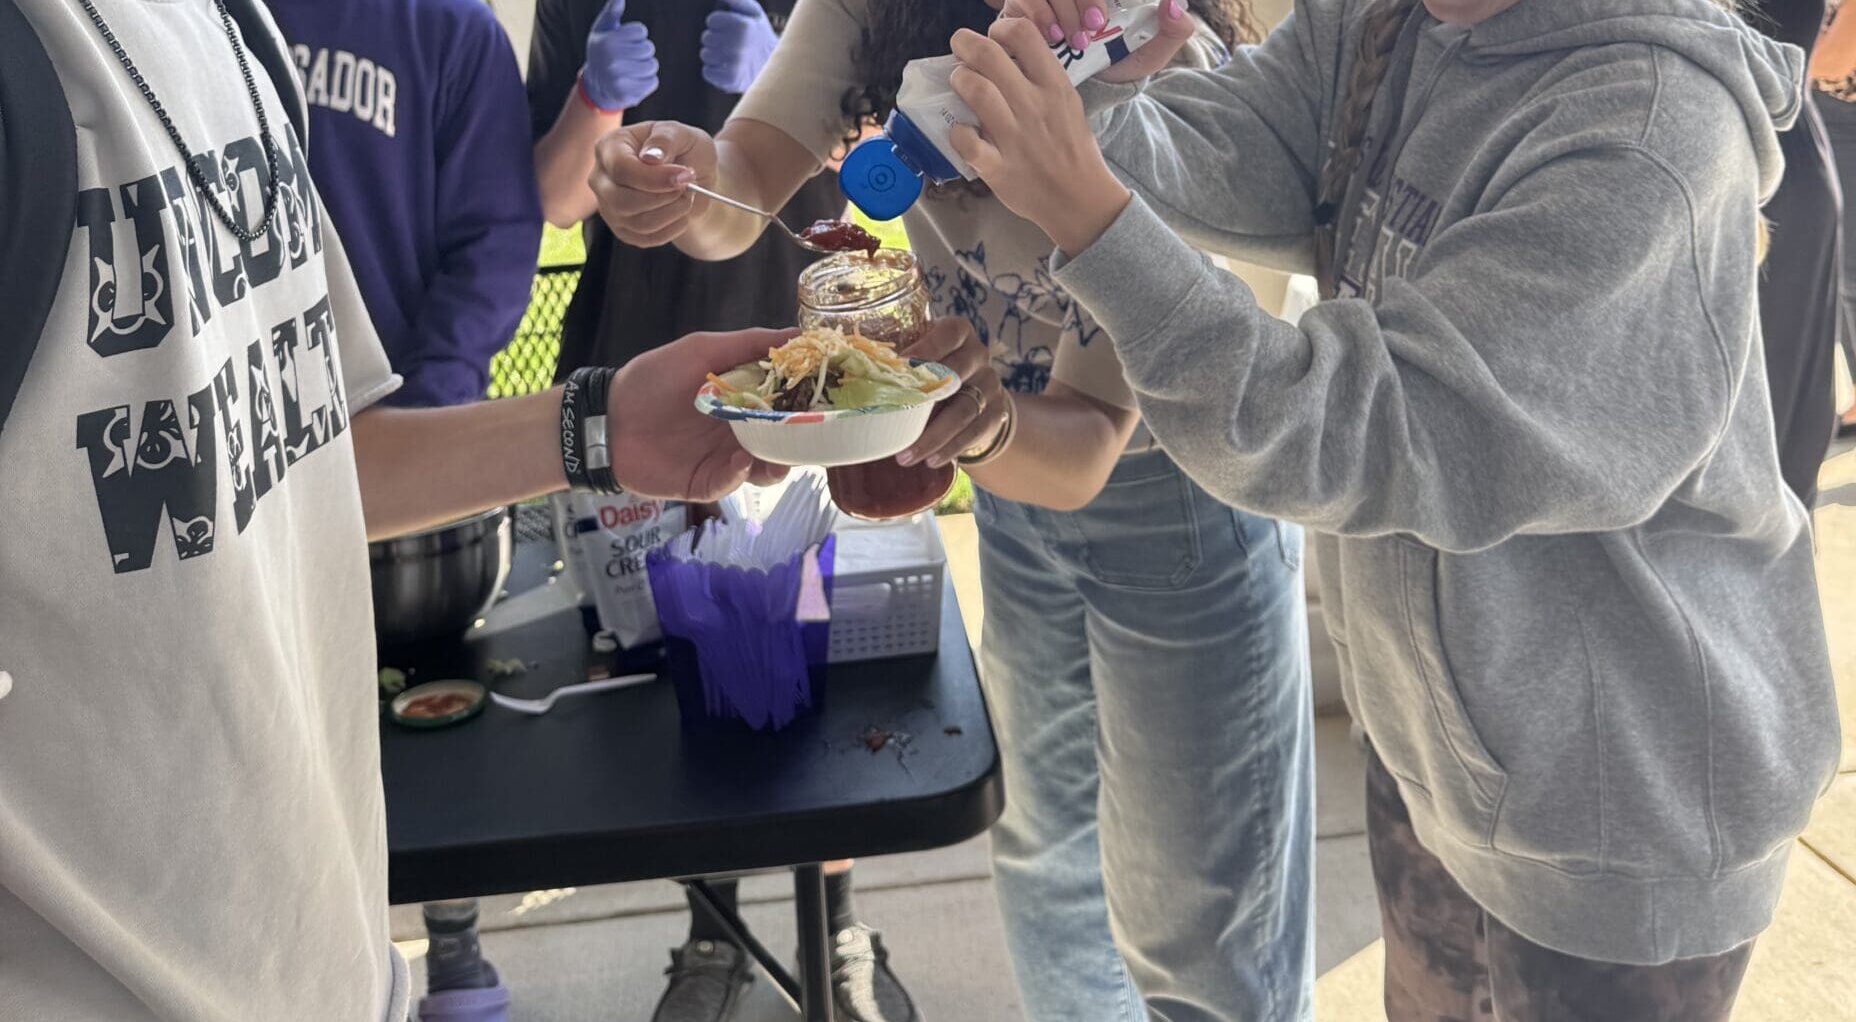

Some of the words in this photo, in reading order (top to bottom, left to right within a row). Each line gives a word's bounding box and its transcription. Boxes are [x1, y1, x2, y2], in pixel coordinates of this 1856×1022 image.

[563, 380, 579, 404] AM
[562, 407, 580, 473] SECOND
[611, 526, 661, 558] SOUR
